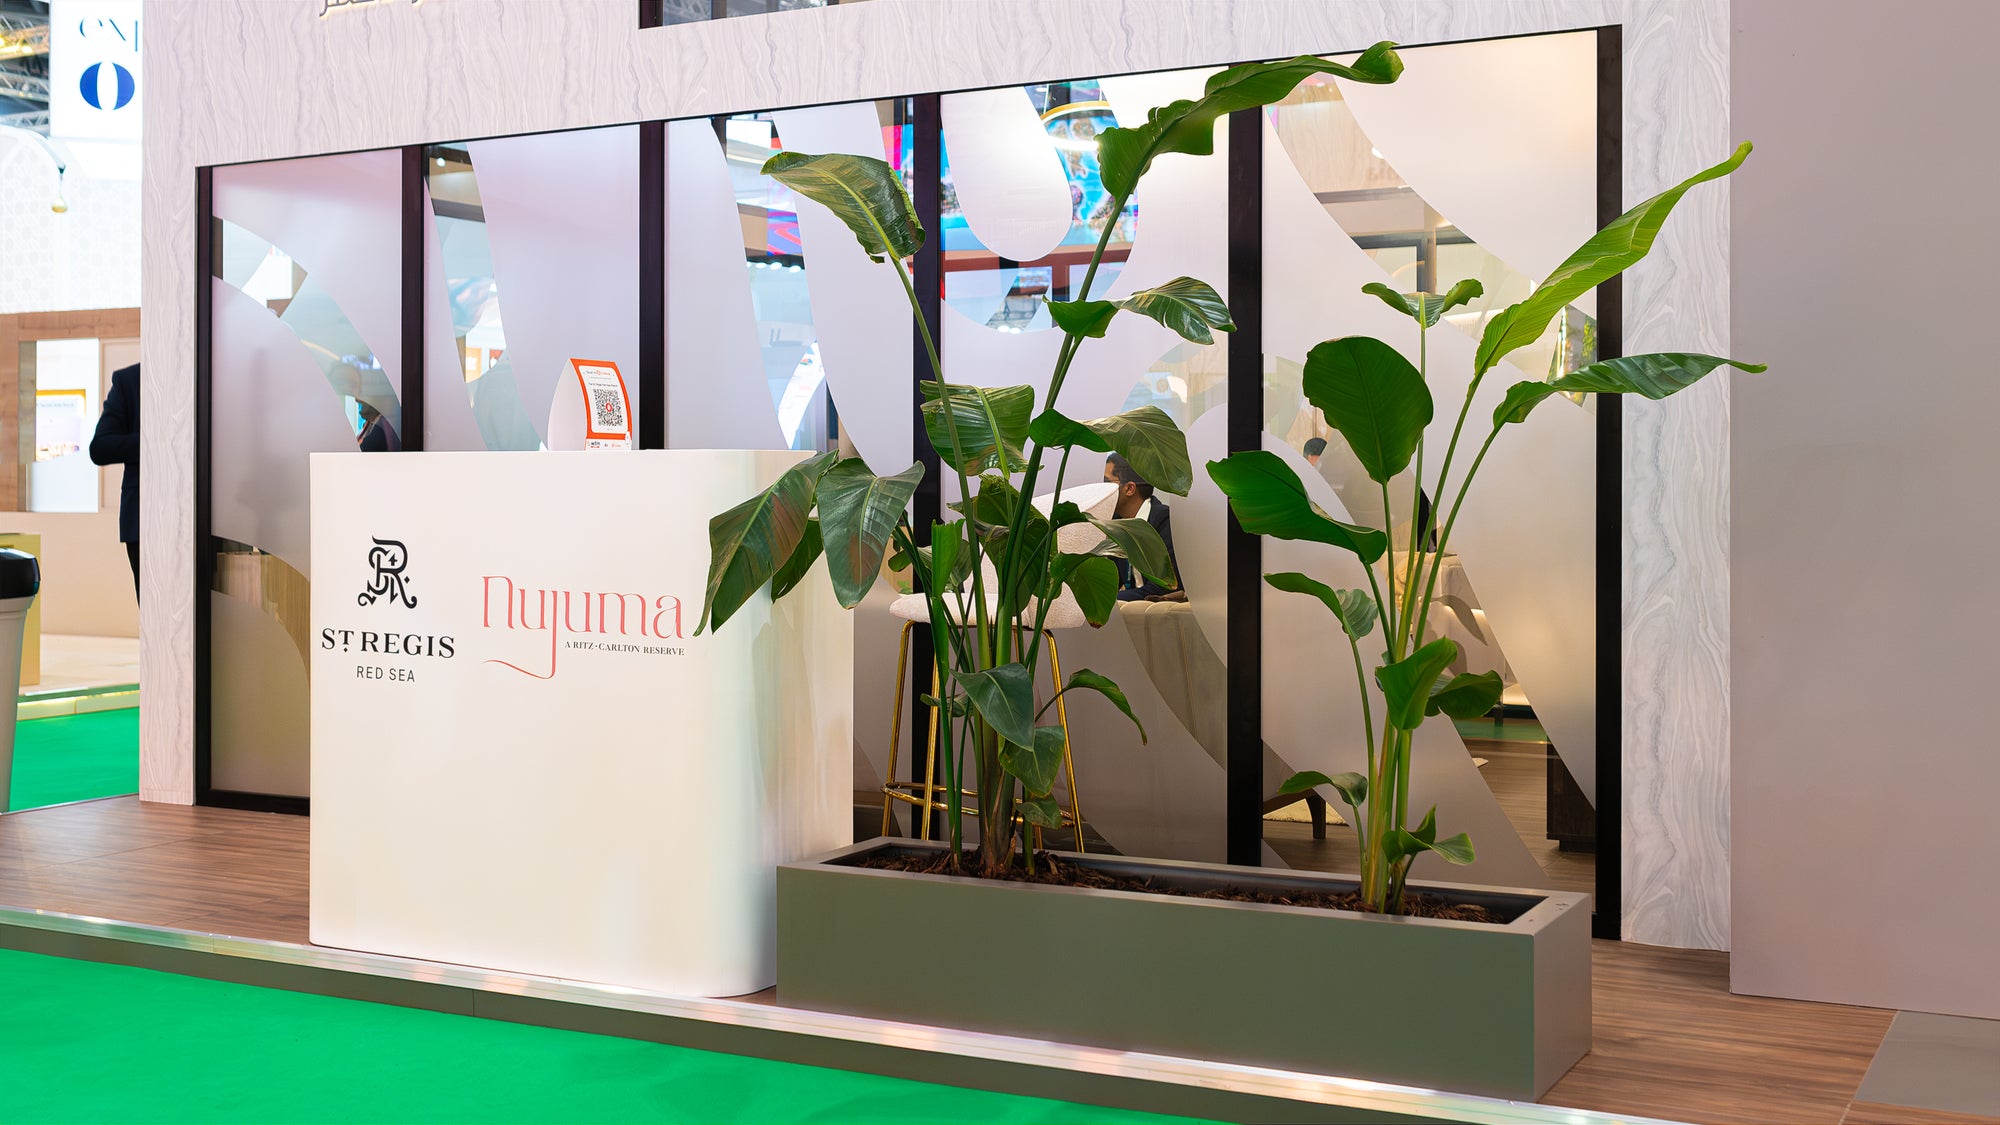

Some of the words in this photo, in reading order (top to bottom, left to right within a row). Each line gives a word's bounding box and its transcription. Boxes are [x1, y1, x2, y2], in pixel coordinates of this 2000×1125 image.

[360, 631, 455, 659] REGIS
[643, 646, 685, 656] RESERVE
[356, 666, 384, 680] RED
[388, 668, 415, 682] SEA
